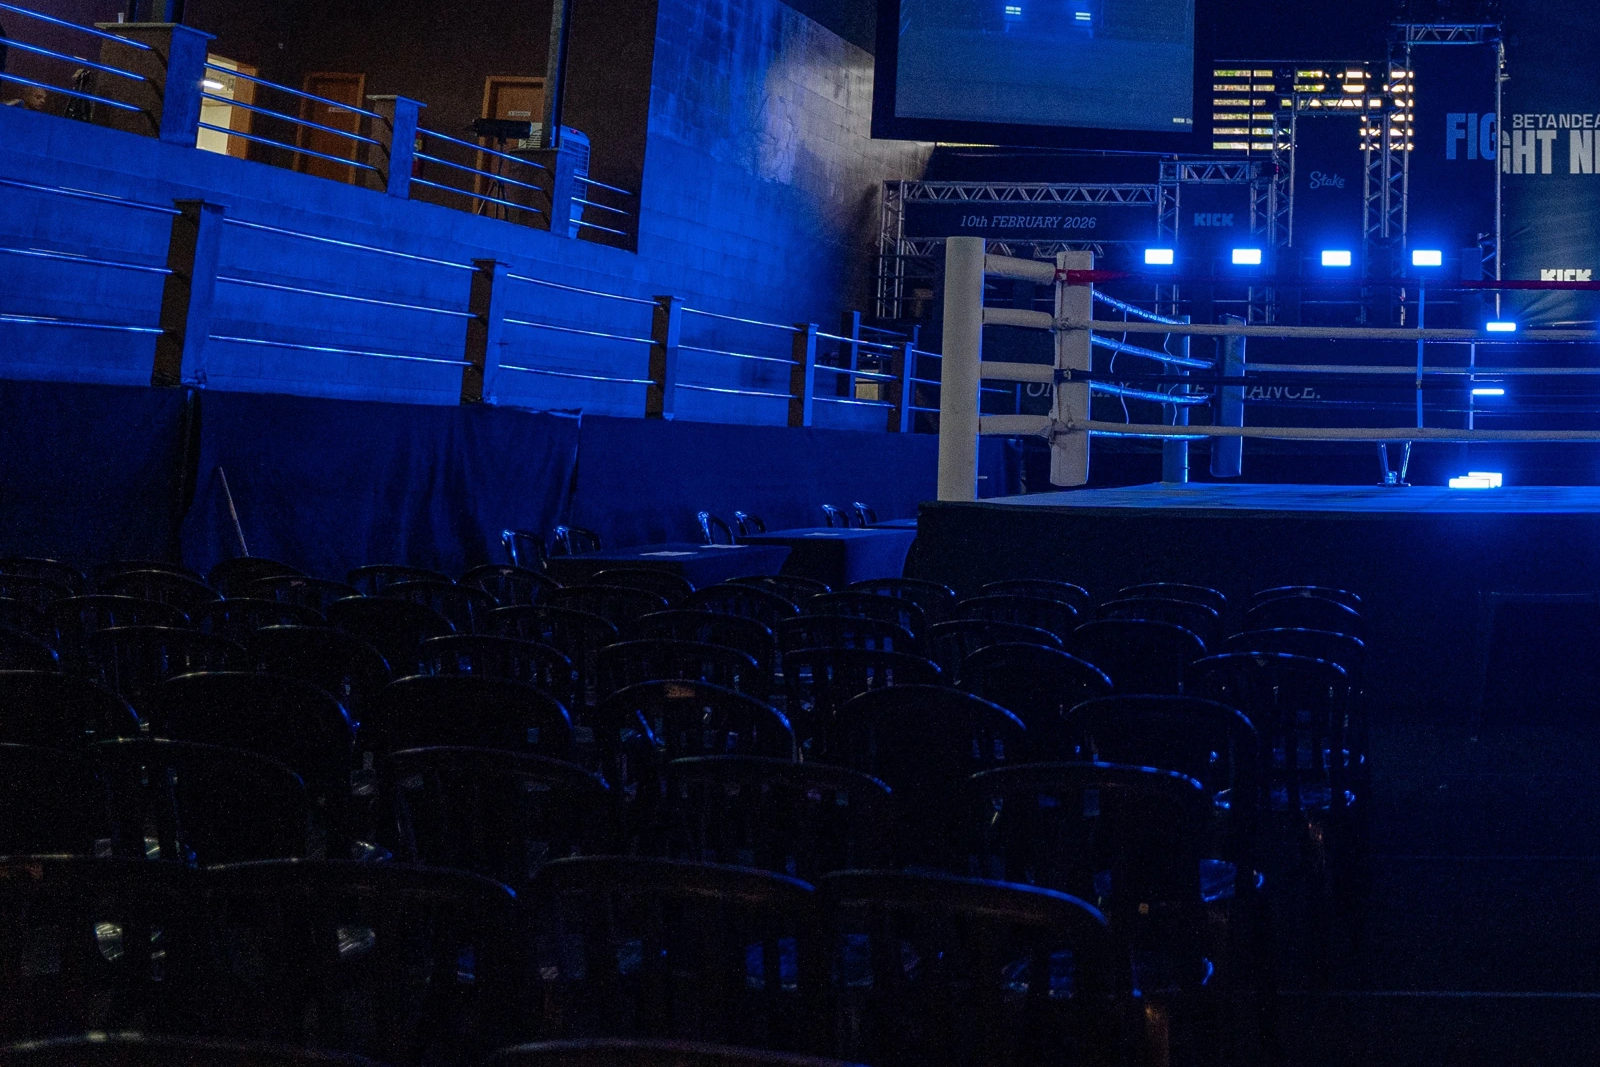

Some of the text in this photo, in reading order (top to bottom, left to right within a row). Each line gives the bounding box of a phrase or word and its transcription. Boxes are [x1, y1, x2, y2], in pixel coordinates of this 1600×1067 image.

[1309, 170, 1346, 190] Stake
[960, 215, 1097, 229] 10th FEBRUARY 2026
[1193, 212, 1235, 227] KICK
